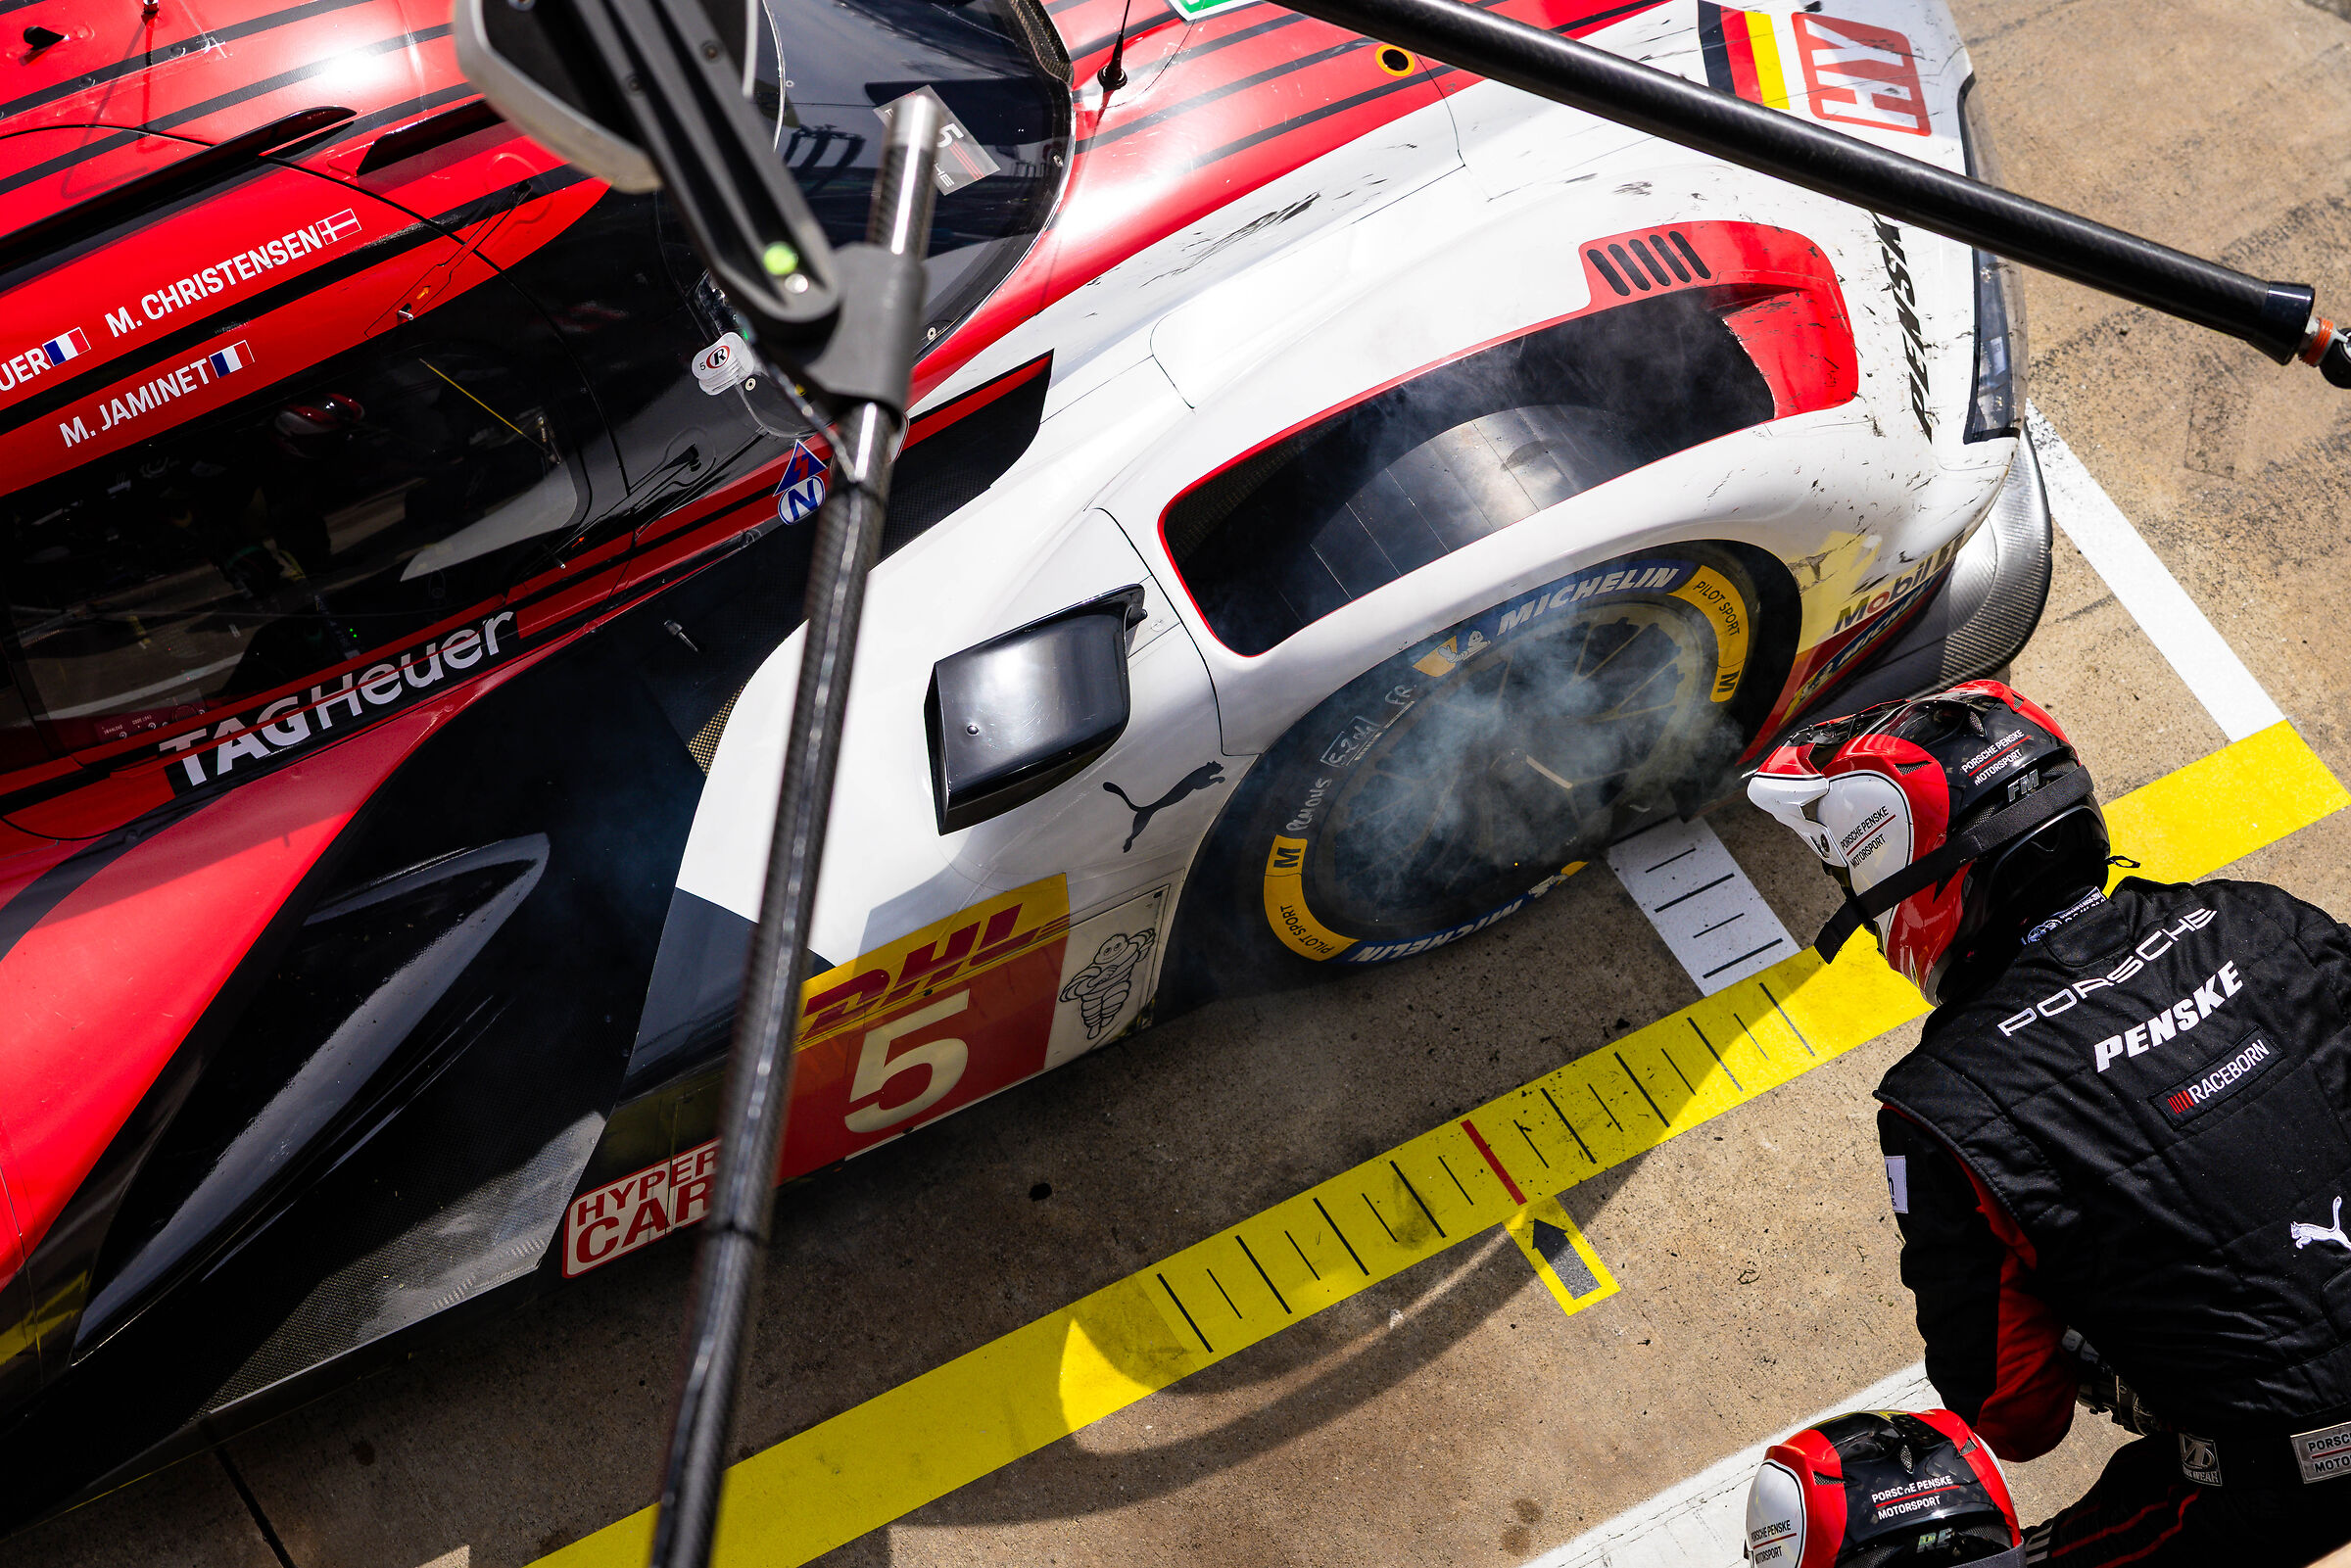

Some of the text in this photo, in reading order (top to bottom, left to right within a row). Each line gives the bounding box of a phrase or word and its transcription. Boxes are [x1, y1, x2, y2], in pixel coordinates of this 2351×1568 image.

[105, 224, 323, 338] M. CHRISTENSEN
[1869, 209, 1933, 446] PENSK
[59, 357, 212, 449] M. JAMINET
[1497, 566, 1681, 637] MICHELIN
[1693, 580, 1741, 637] PILOT SPORT
[1833, 550, 1934, 636] Mobil
[1717, 670, 1741, 693] M
[1961, 729, 2025, 773] PORSCHE PENSKE
[1974, 748, 2023, 785] MOTORSPORT
[2007, 768, 2039, 803] FM
[1273, 846, 1302, 869] M
[1840, 805, 1890, 851] PORSCHE PENSKE
[1849, 832, 1887, 870] MOTORSPORT
[1279, 904, 1334, 954] PILOT SPORT
[1348, 898, 1523, 962] MICHELIN
[797, 901, 1041, 1043] DHL
[1996, 907, 2218, 1037] PORSCHE
[2092, 960, 2244, 1073] PENSKE
[844, 987, 971, 1134] 5
[2187, 1038, 2271, 1105] RACEBORN
[576, 1145, 721, 1228] HYPER
[575, 1173, 717, 1264] CAR
[2307, 1433, 2351, 1452] PORSC
[2314, 1454, 2351, 1474] MOTO
[1877, 1495, 1941, 1521] MOTORSPORT
[1916, 1475, 1954, 1492] PENSKE
